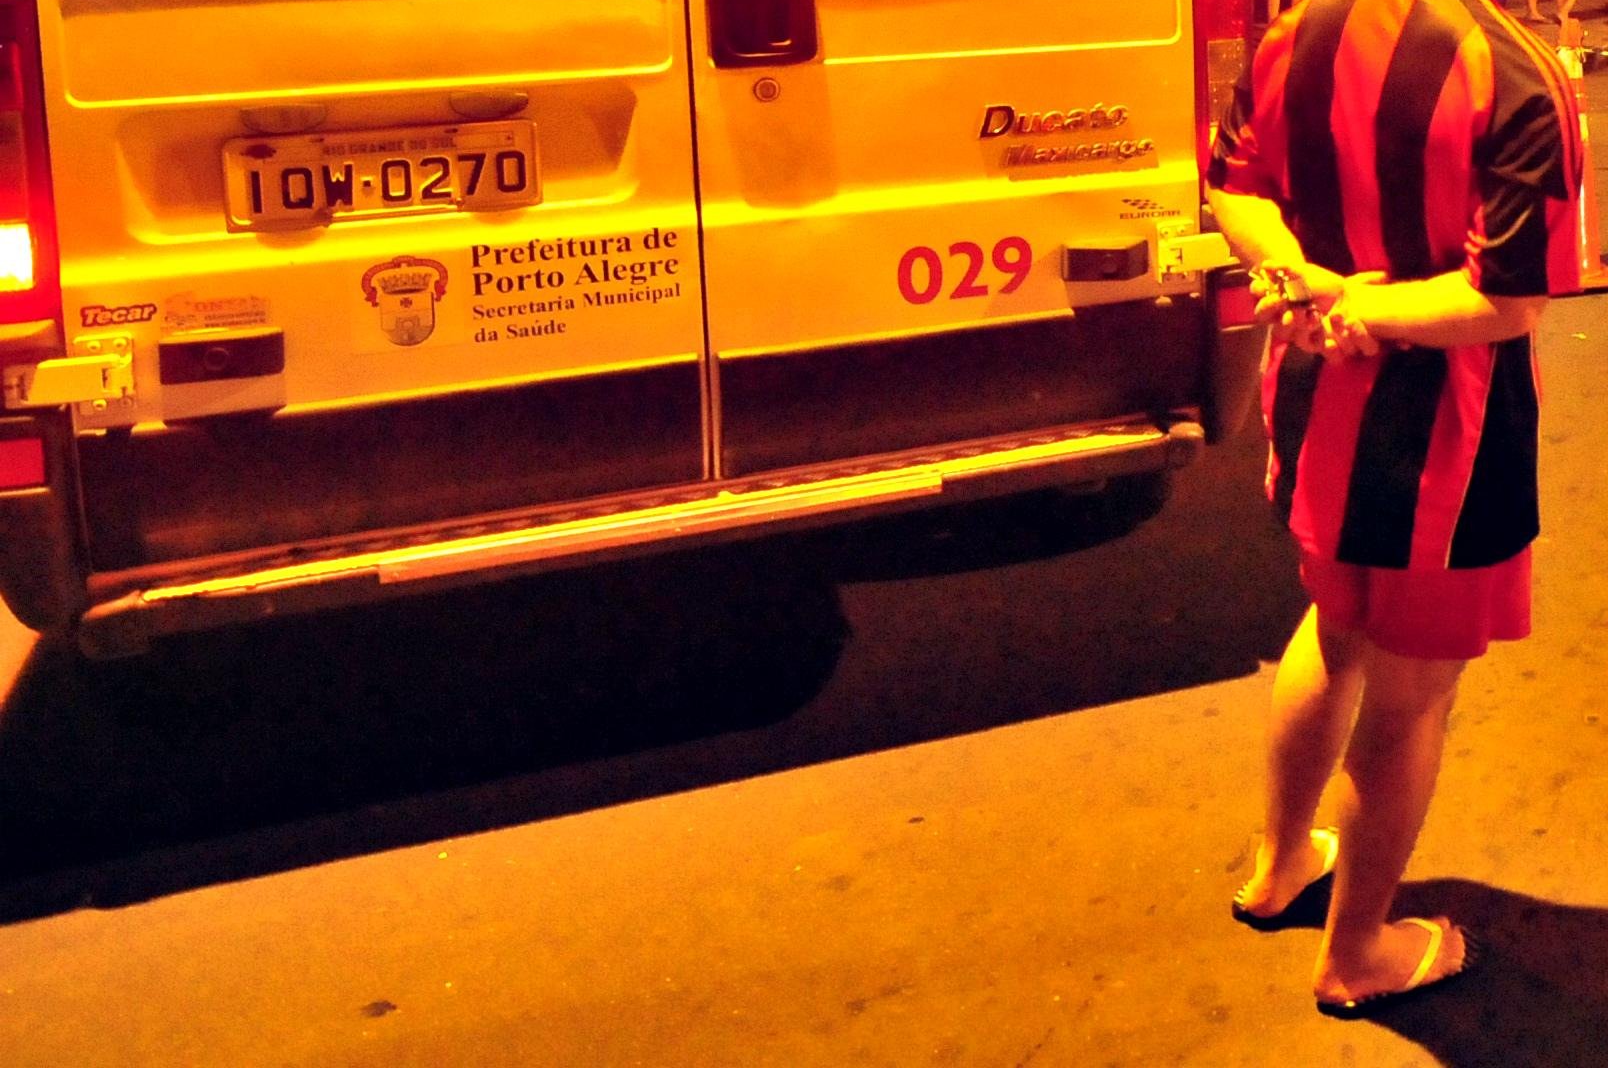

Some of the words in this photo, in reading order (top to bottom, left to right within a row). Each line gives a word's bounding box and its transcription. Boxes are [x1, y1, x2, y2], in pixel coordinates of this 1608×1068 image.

[978, 102, 1129, 139] Ducato
[471, 238, 632, 268] Prefeitura
[643, 228, 678, 250] de
[472, 268, 565, 296] Porto
[574, 258, 679, 286] Alegre
[897, 235, 1033, 305] 029
[81, 303, 157, 327] Tecar
[472, 295, 575, 320] Secretaria
[583, 283, 681, 308] Municipal
[474, 327, 499, 343] da
[506, 319, 567, 340] Saúde
